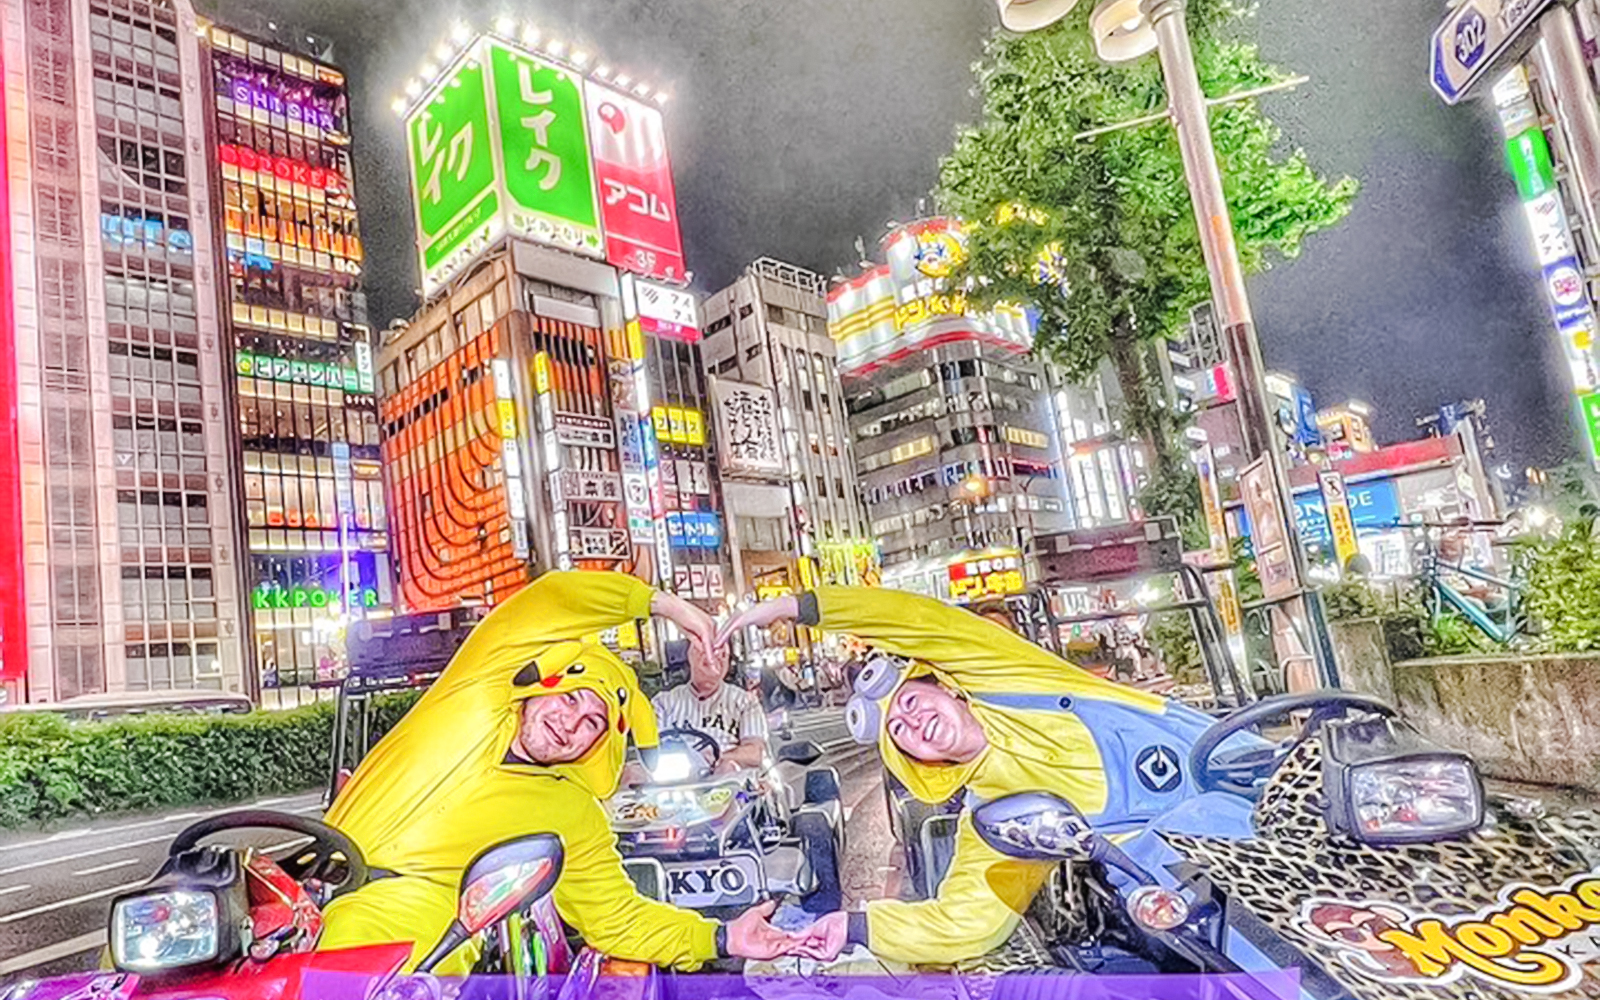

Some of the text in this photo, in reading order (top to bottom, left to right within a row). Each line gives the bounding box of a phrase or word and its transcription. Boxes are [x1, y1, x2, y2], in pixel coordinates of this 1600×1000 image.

[1456, 14, 1486, 63] 302
[516, 61, 562, 190] レイク
[418, 121, 473, 205] レイク
[603, 177, 671, 222] アコム
[254, 587, 378, 608] KKPOKER
[669, 866, 746, 896] KYO
